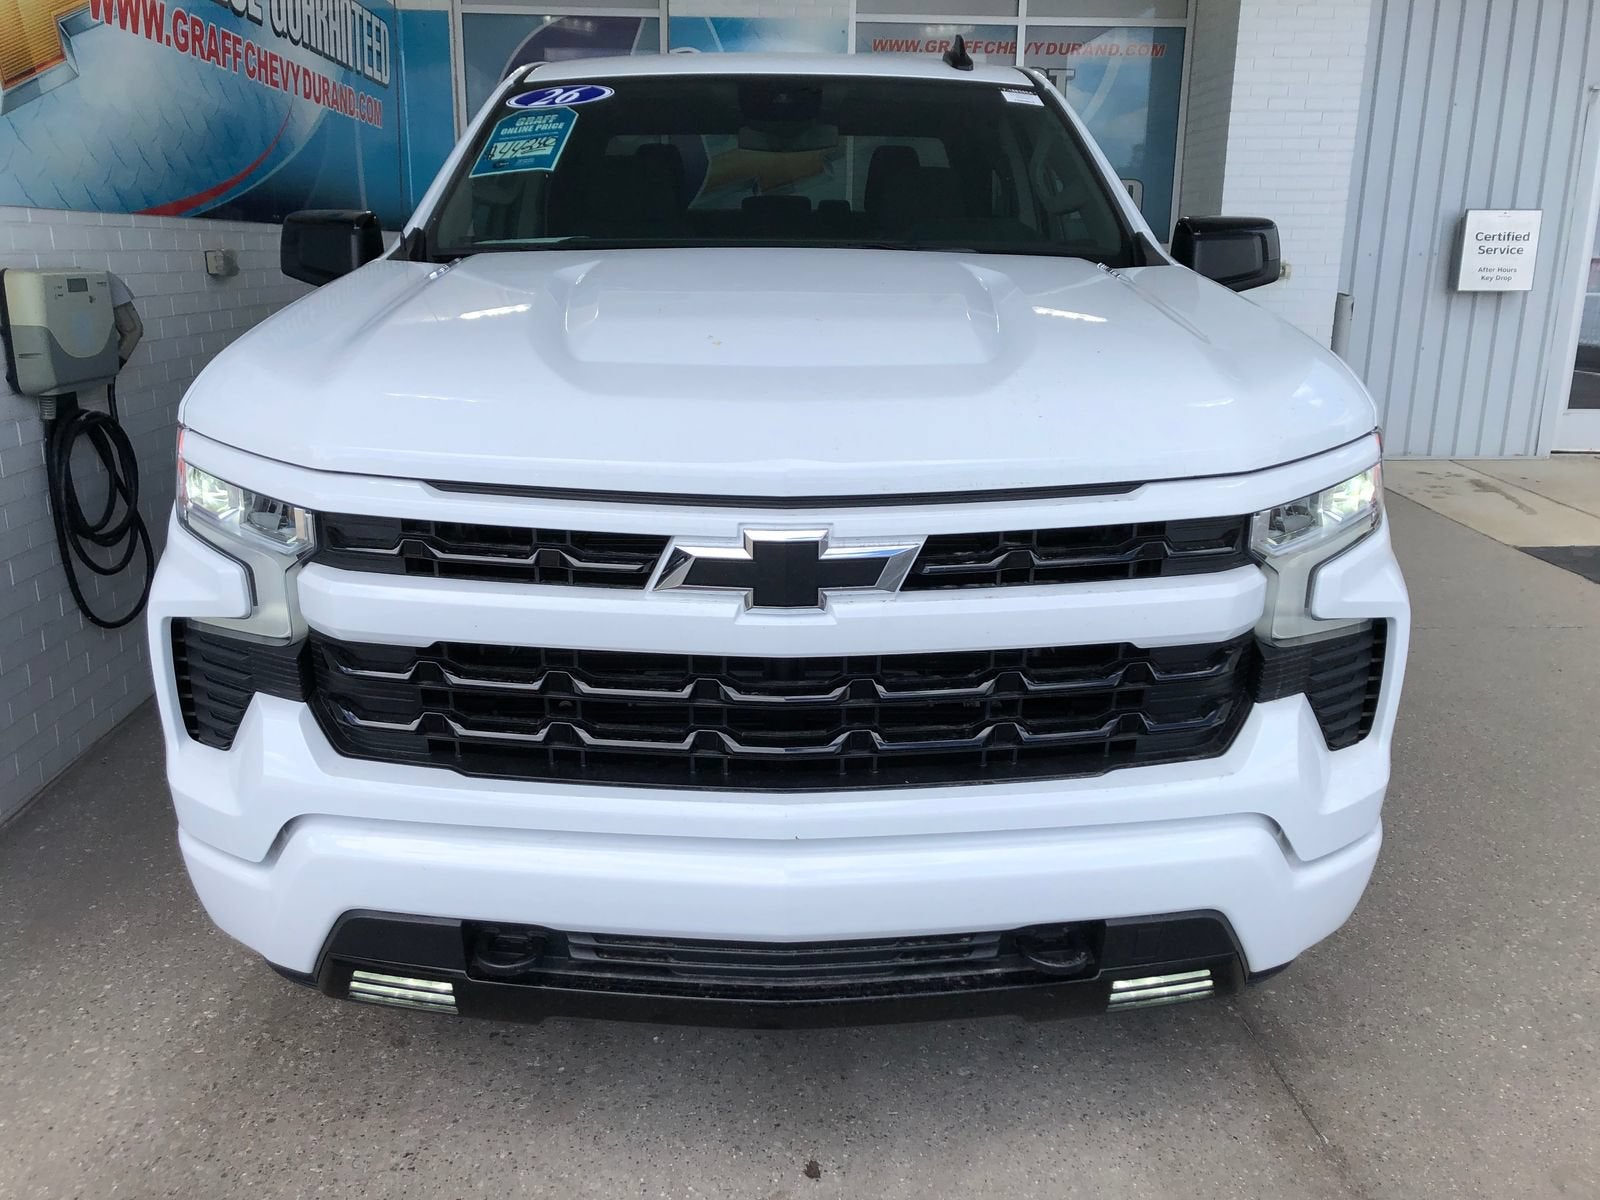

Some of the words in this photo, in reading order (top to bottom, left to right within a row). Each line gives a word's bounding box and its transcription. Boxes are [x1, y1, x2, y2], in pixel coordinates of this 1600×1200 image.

[872, 38, 1168, 57] WWW.GRFFCHEYDURAND.COM
[528, 87, 591, 106] 26
[516, 114, 559, 127] GRAFF
[500, 125, 534, 135] ONLINE
[535, 122, 565, 131] PRICE
[1475, 231, 1531, 242] Certified
[1477, 245, 1524, 255] Service
